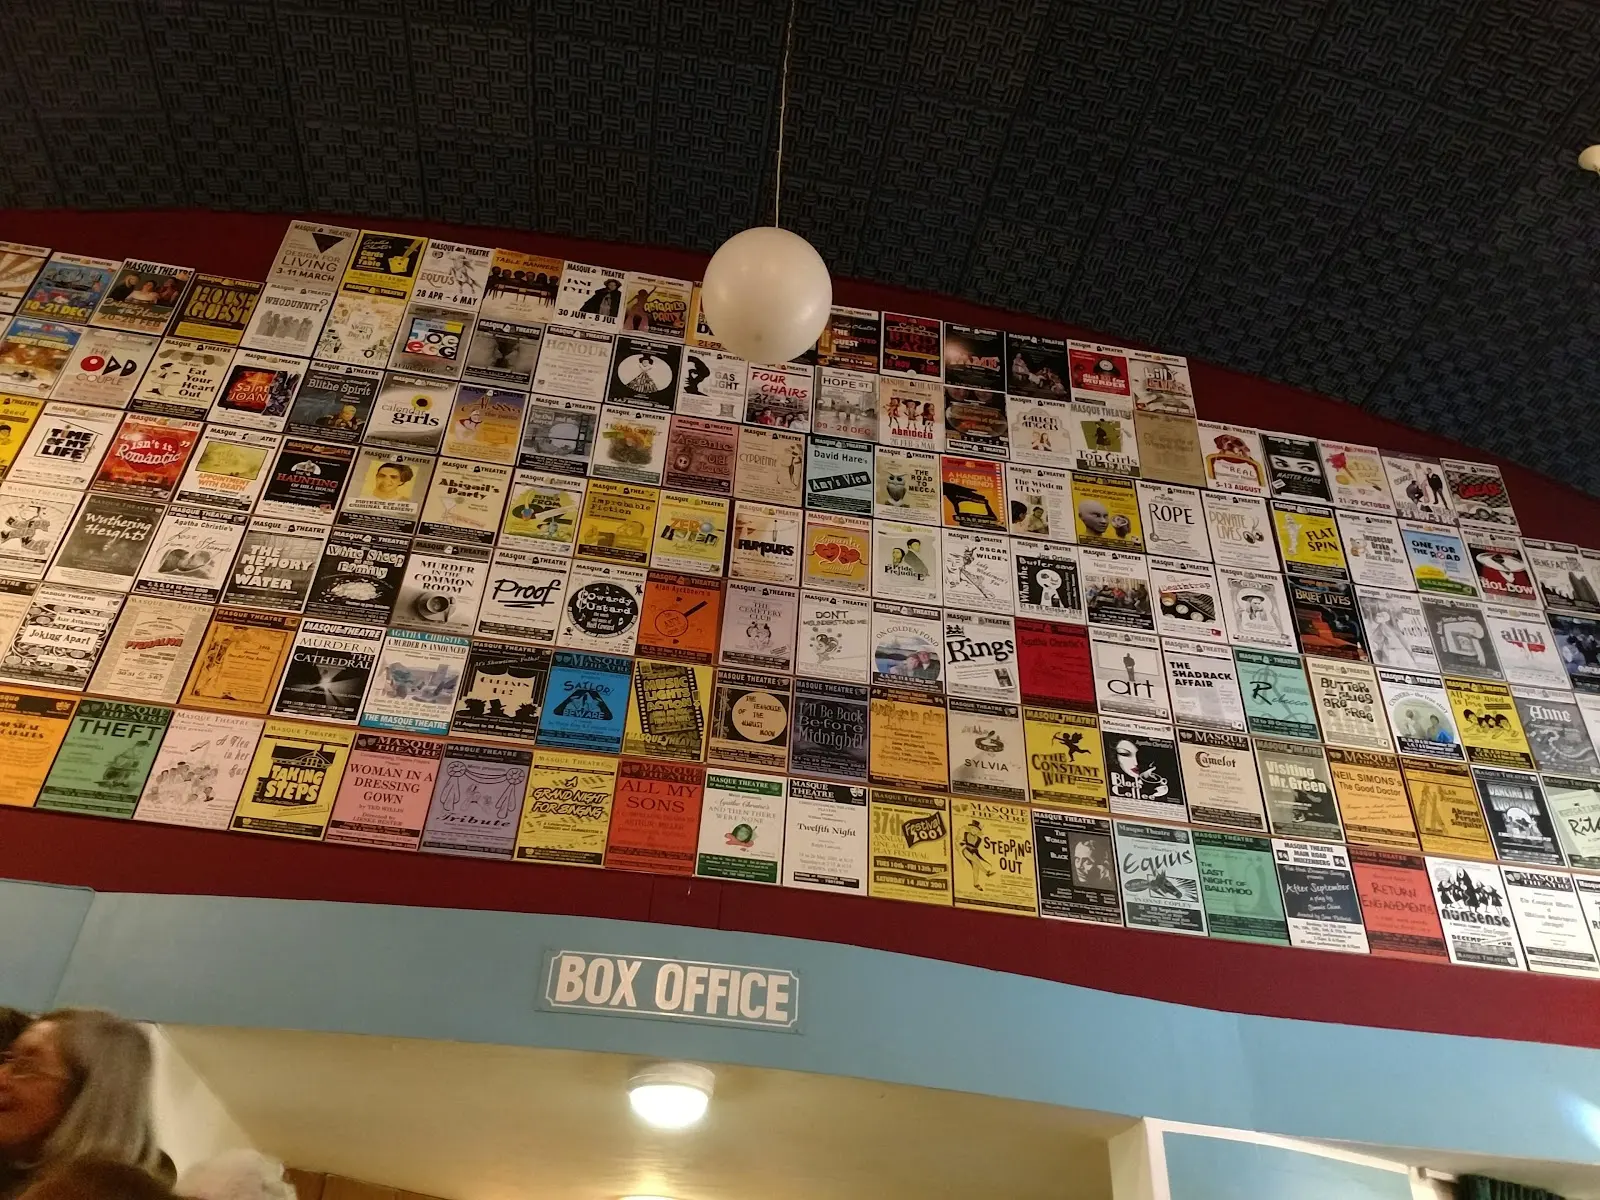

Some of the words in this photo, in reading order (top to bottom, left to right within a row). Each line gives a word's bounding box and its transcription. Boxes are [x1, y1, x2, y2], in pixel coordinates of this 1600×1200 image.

[284, 248, 319, 262] DESIGN
[431, 242, 456, 252] MASQUE
[465, 247, 490, 258] THEATRE
[124, 261, 158, 274] MASQUE
[158, 265, 193, 278] THEATRE
[281, 255, 337, 273] LIVING
[567, 263, 589, 273] MASQUE
[601, 269, 625, 279] THEATRE
[253, 520, 281, 529] MASQUE
[296, 525, 325, 534] THEATRE
[304, 621, 345, 636] MASQUE
[341, 625, 381, 640] THEATRE
[473, 641, 501, 649] MASQUE
[502, 644, 537, 653] THEATRE
[293, 651, 371, 670] CATHEDRAL
[719, 671, 748, 681] MASQUE
[749, 675, 776, 685] THEATRE
[1107, 679, 1155, 699] art
[383, 716, 411, 726] MASQUE
[412, 719, 448, 730] THEATRE
[668, 784, 697, 798] MY
[554, 955, 643, 1008] BOX
[654, 963, 790, 1022] OFFICE
